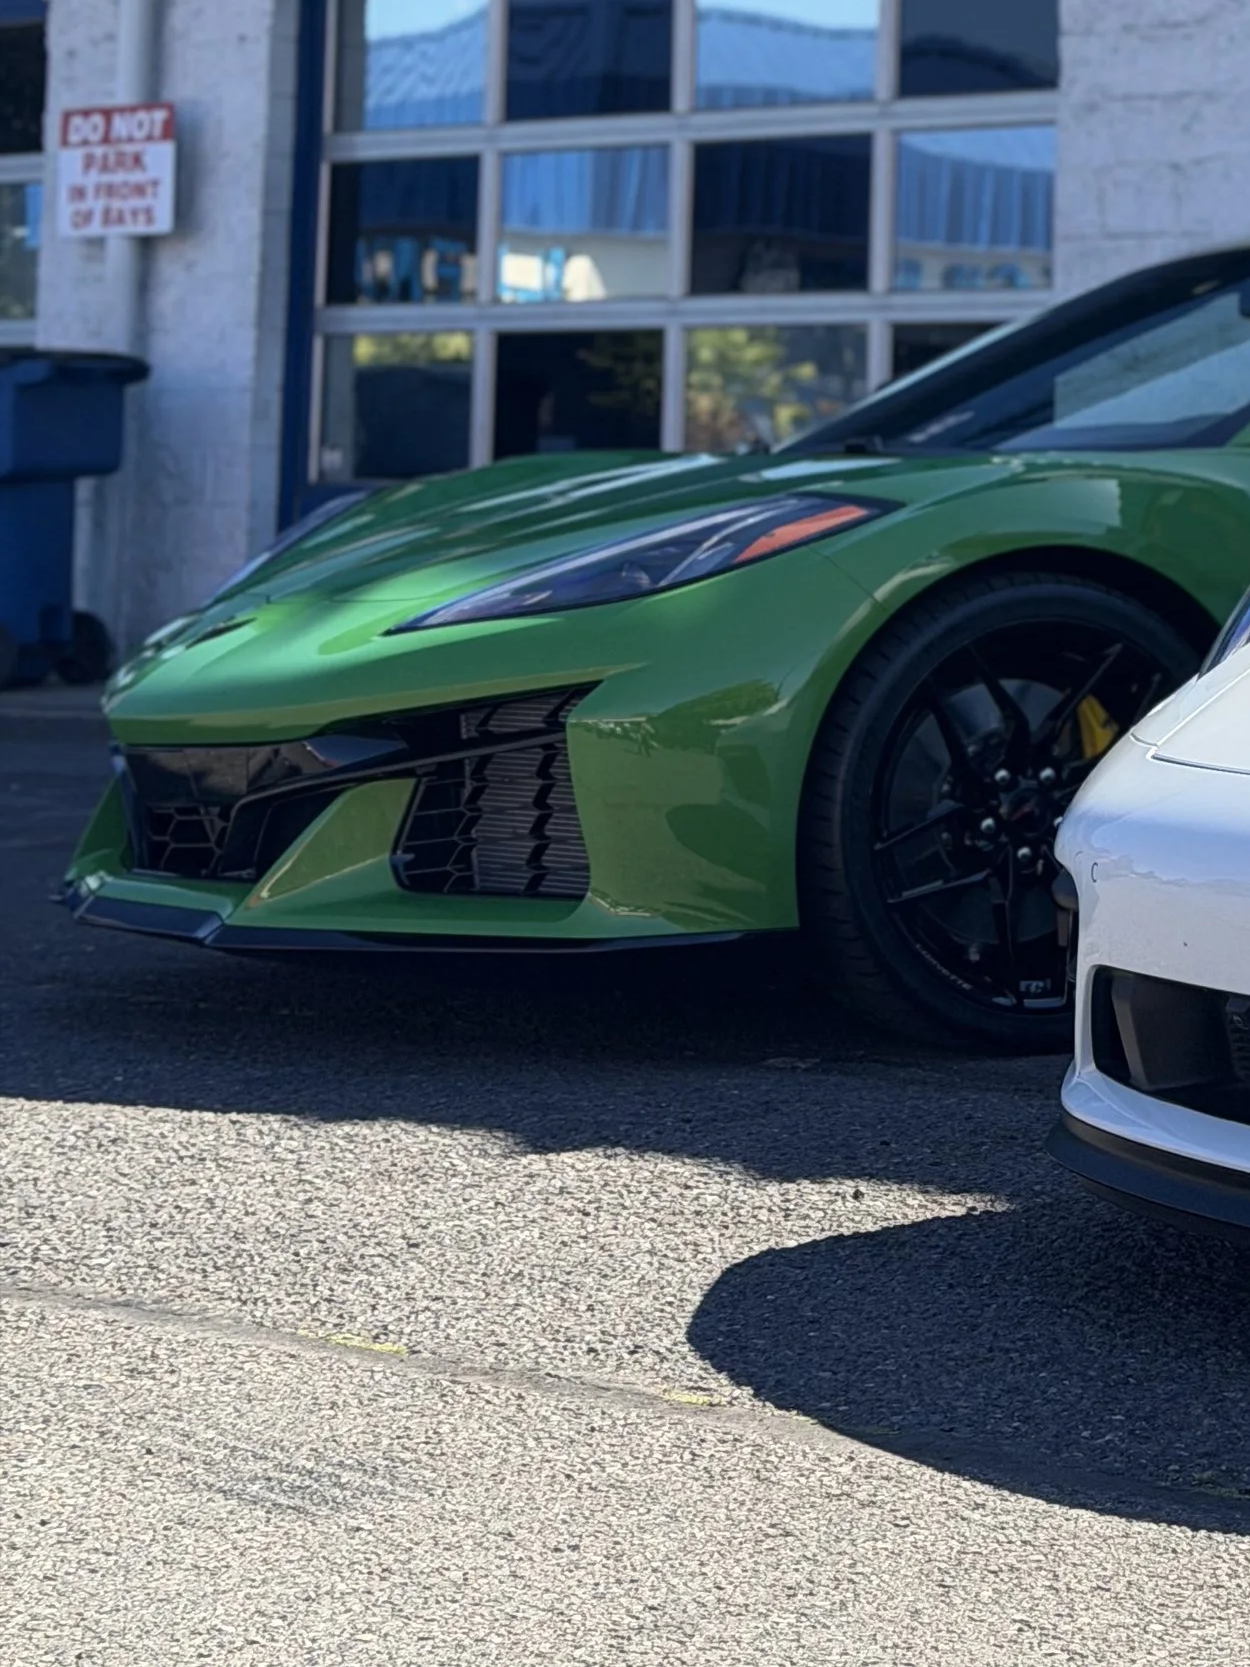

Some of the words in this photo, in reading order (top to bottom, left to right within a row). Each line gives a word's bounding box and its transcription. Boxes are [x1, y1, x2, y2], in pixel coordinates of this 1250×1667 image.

[67, 112, 106, 145] DO
[109, 108, 170, 141] NOT
[83, 150, 147, 174] PARK
[69, 184, 87, 203] IN
[93, 179, 160, 202] FRONT
[71, 207, 94, 230] OF
[101, 204, 154, 228] BAYS
